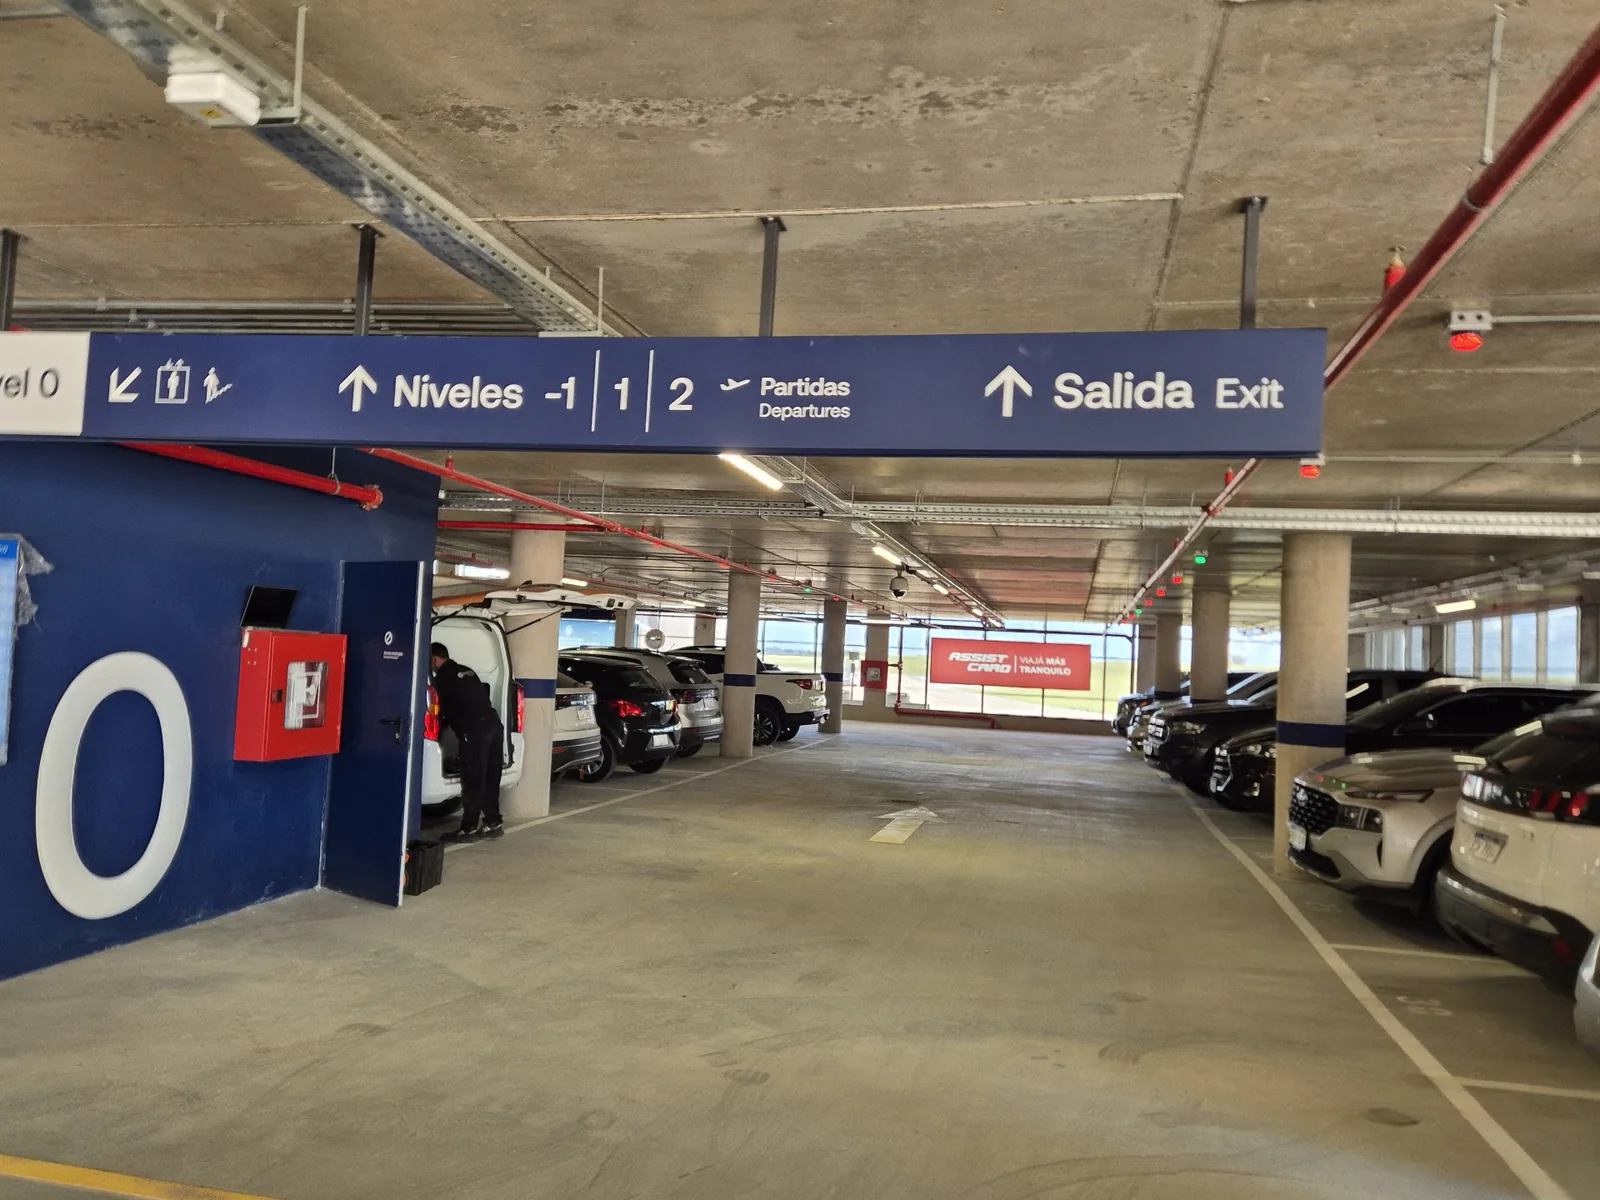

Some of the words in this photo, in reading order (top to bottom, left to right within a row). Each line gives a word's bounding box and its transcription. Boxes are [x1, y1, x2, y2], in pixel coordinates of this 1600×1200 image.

[0, 367, 31, 398] el
[40, 368, 60, 399] 0
[393, 374, 524, 409] Niveles
[544, 376, 576, 410] -1
[614, 377, 629, 410] 1
[668, 377, 694, 411] 2
[760, 377, 851, 397] Partidas
[1053, 371, 1195, 410] Salida
[1215, 376, 1285, 409] Exit
[758, 402, 851, 422] Departures
[948, 651, 1009, 664] ASSIST
[1046, 656, 1066, 666] MÁS
[967, 662, 1012, 674] CARD
[1019, 665, 1072, 676] TRANQUILO
[35, 650, 192, 920] 0
